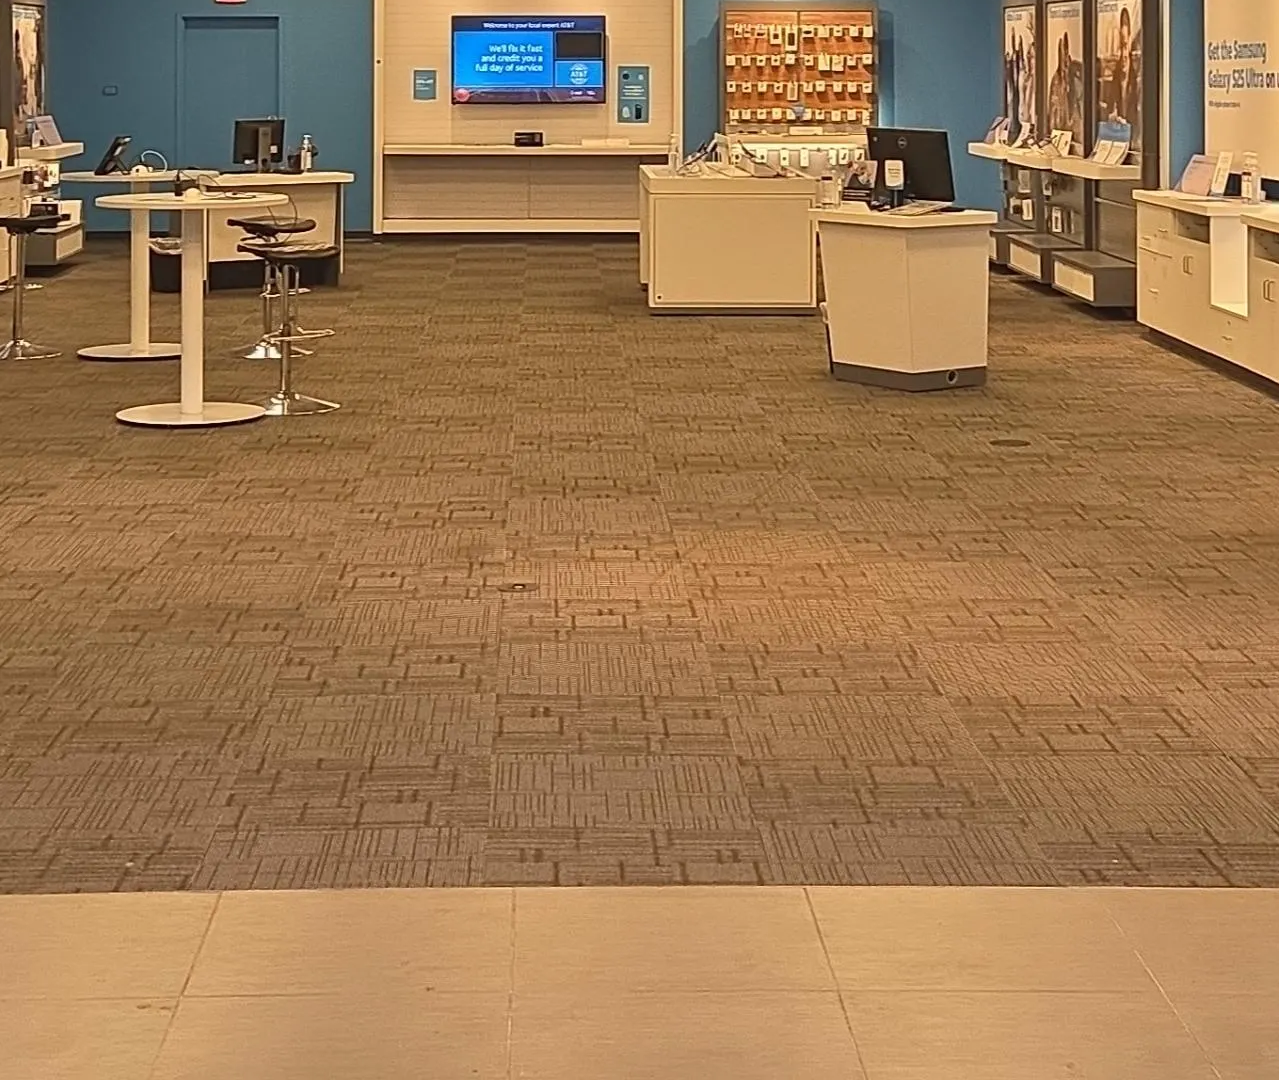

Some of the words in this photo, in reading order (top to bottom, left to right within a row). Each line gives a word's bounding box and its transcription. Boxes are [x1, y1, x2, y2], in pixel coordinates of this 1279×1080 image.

[1207, 41, 1220, 61] Get
[1220, 40, 1232, 60] the
[1233, 40, 1266, 64] Samsung
[1207, 69, 1232, 94] Galaxy
[1245, 68, 1264, 89] Ultra
[1265, 71, 1276, 88] on
